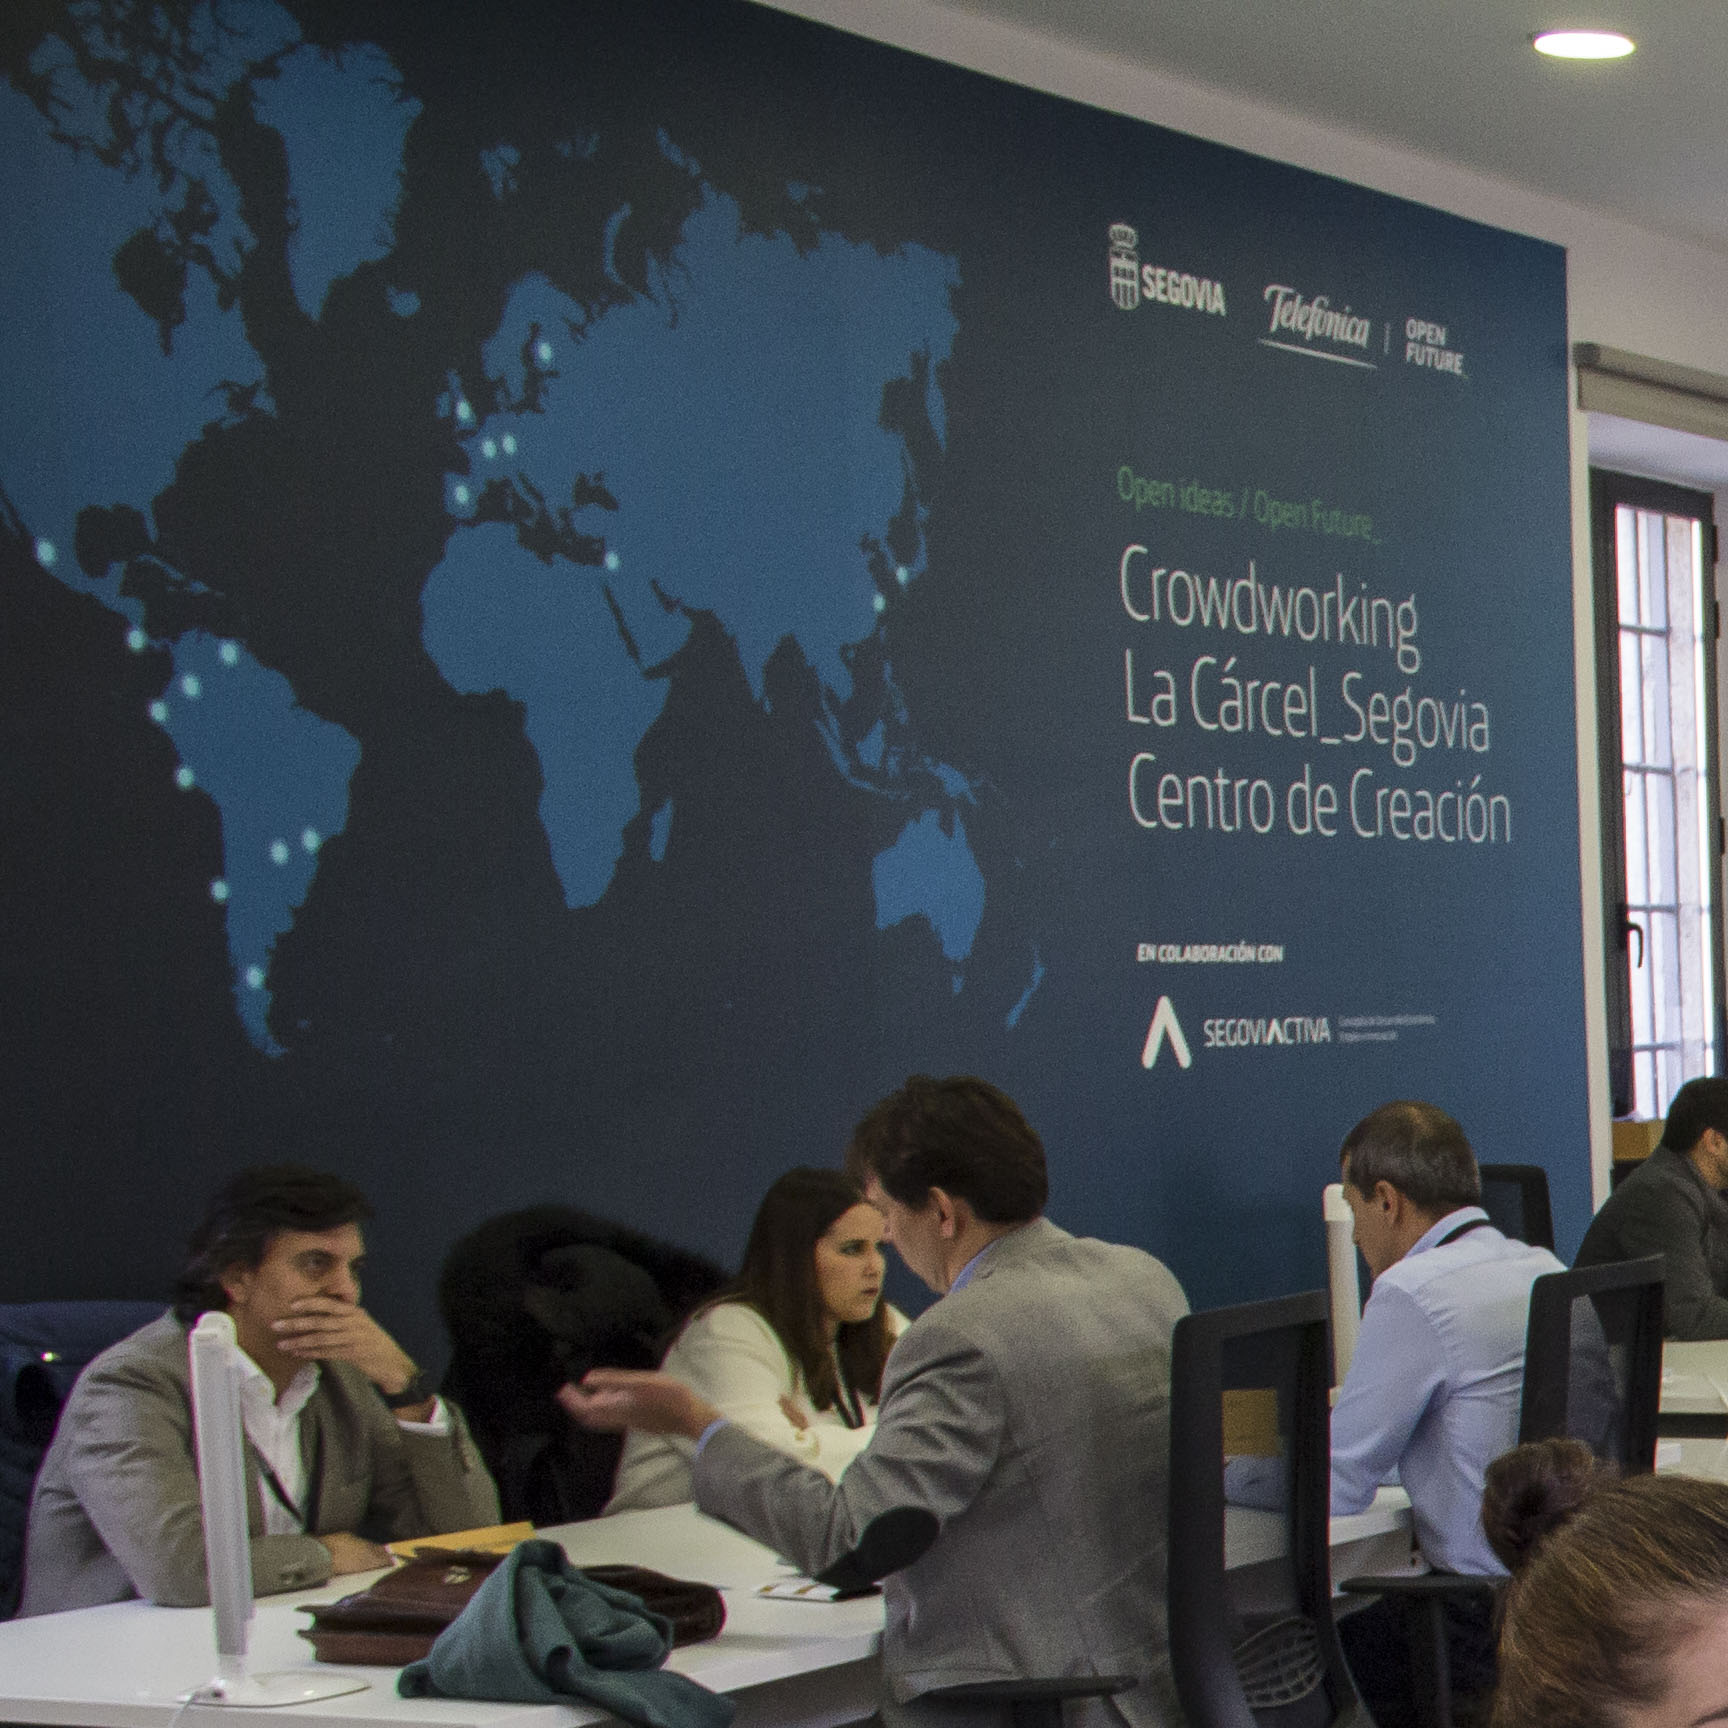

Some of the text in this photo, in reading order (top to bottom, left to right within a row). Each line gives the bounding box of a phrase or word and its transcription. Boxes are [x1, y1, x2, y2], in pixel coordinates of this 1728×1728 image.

[1141, 264, 1226, 317] SEGOVIA
[1406, 318, 1446, 345] OPEN
[1117, 466, 1175, 511] Open
[1180, 476, 1234, 518] ideas
[1255, 490, 1308, 535] Open
[1120, 544, 1421, 674] Crowdworking
[1126, 648, 1176, 726] La
[1129, 752, 1511, 843] Centro de Creación
[1137, 941, 1284, 963] EN COLABORACIÓN CON
